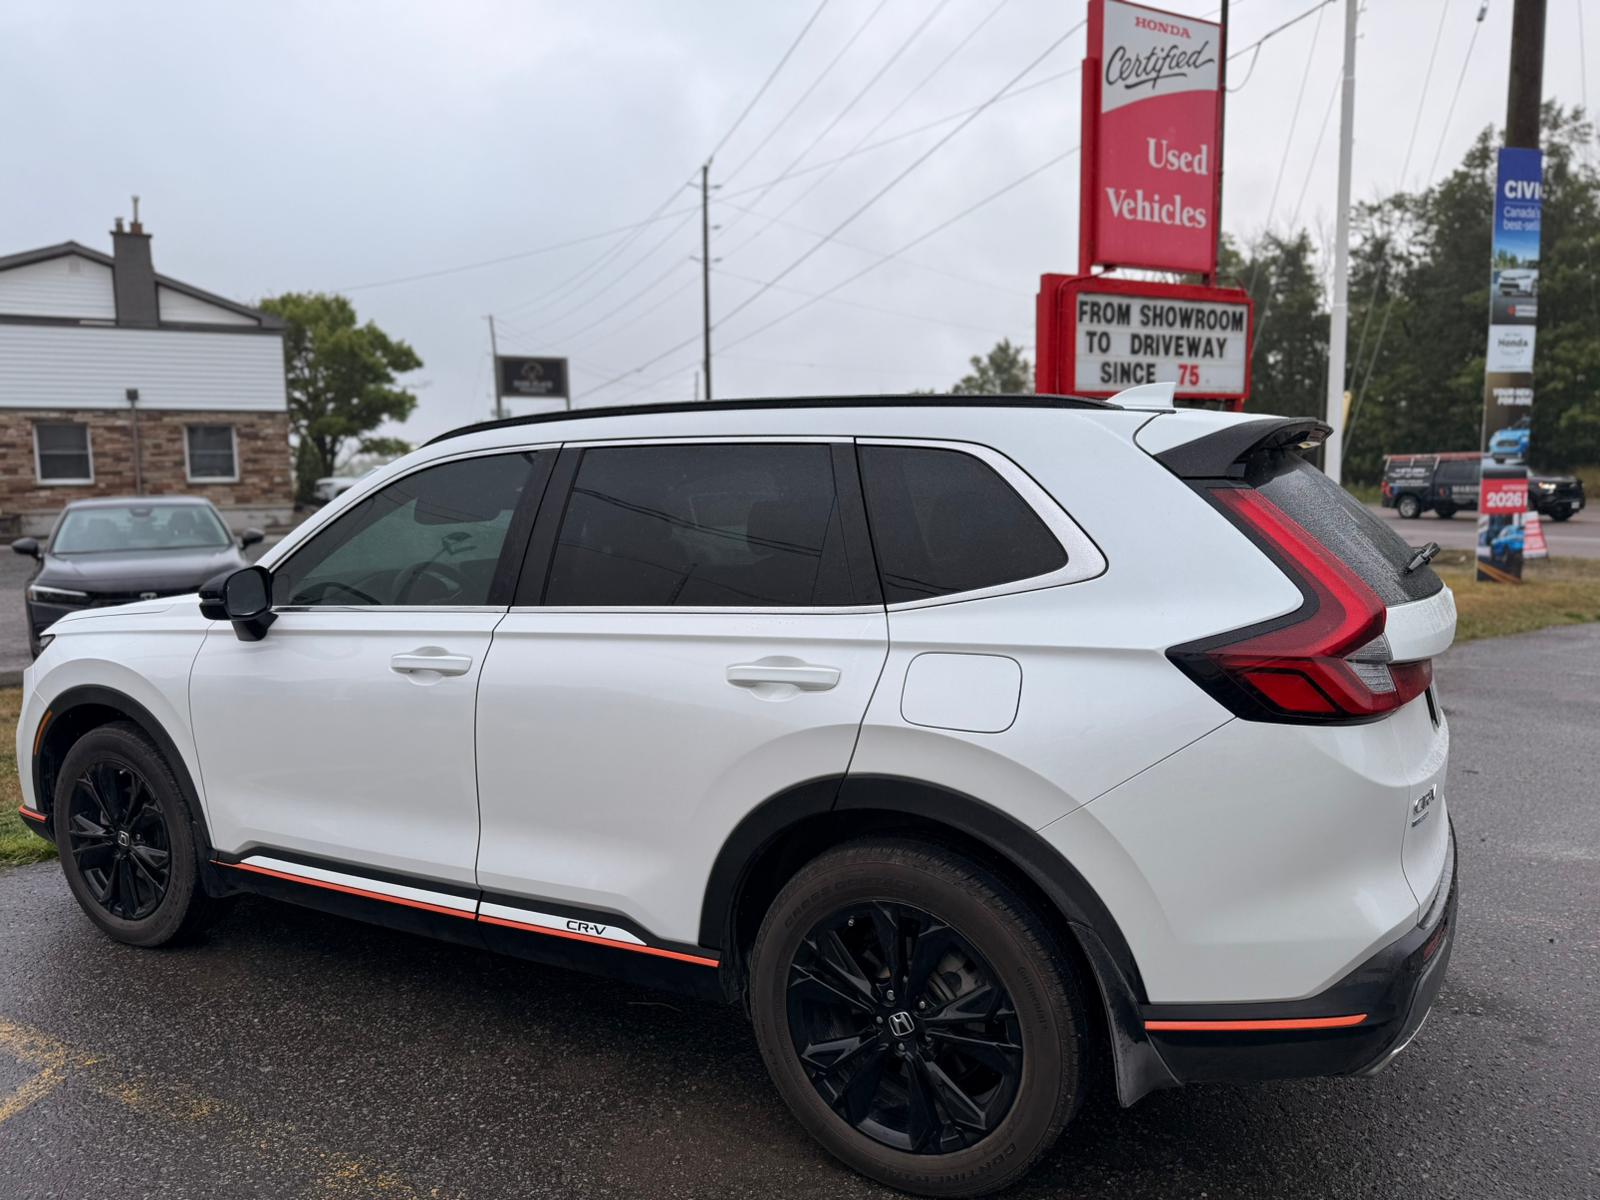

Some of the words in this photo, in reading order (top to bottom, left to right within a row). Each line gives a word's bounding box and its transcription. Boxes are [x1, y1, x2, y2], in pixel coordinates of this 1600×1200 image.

[1135, 16, 1191, 39] HONDA
[1105, 40, 1215, 90] Certified
[1146, 136, 1208, 176] Used
[1105, 186, 1207, 230] Vehicles
[1078, 300, 1131, 325] FROM
[1140, 305, 1244, 332] SHOWROOM
[1086, 331, 1111, 353] TO
[1130, 333, 1228, 359] DRIVEWAY
[1101, 361, 1156, 385] SINCE
[1177, 363, 1200, 387] 75
[1487, 491, 1522, 508] 2026
[566, 920, 607, 935] CR-V
